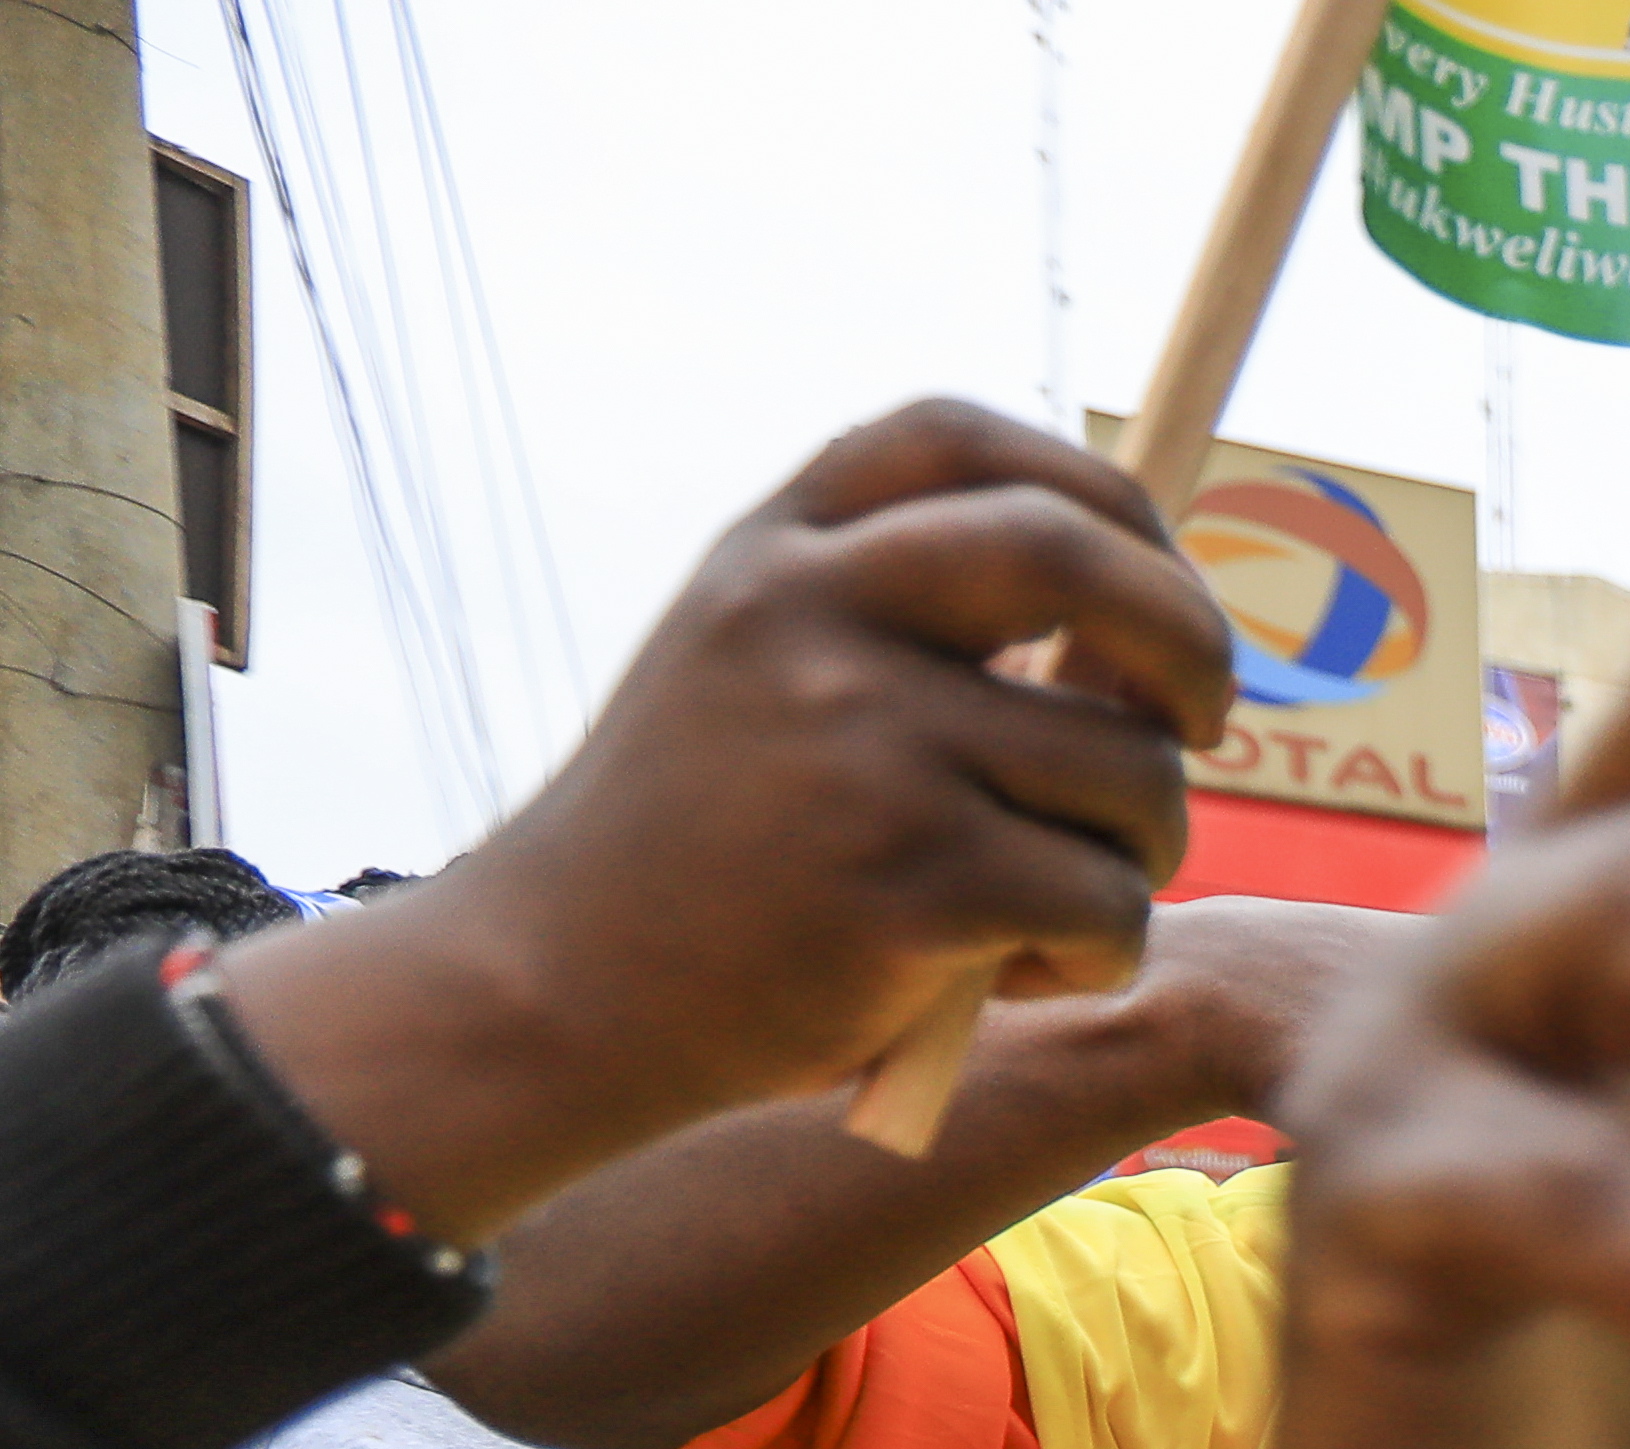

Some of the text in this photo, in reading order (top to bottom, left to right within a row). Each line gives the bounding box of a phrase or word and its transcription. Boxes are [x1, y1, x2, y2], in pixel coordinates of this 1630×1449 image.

[1383, 18, 1490, 109] very
[1361, 64, 1473, 174] MP
[1191, 725, 1468, 808] OTAL
